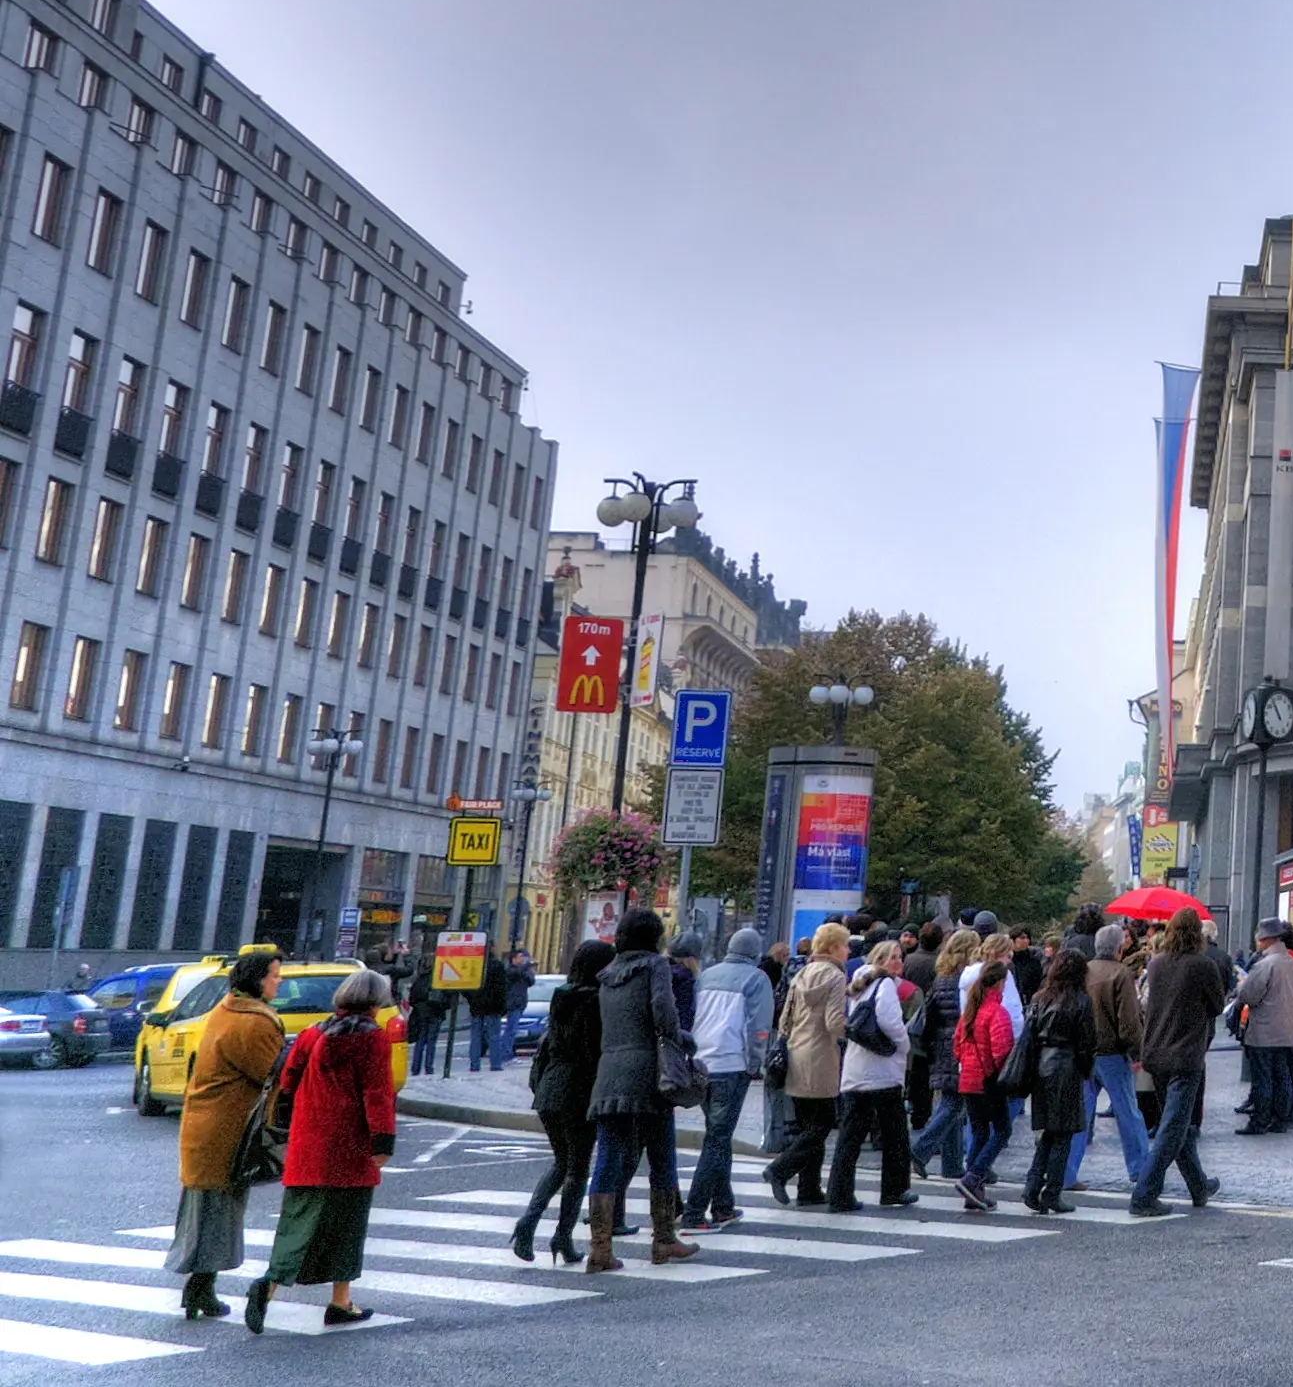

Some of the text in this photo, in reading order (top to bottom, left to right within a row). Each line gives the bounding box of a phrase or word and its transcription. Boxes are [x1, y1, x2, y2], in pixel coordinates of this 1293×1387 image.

[1276, 463, 1293, 473] KB
[578, 622, 611, 635] 170m
[684, 700, 717, 743] P
[478, 800, 502, 809] PLACE
[460, 832, 491, 850] TAXI
